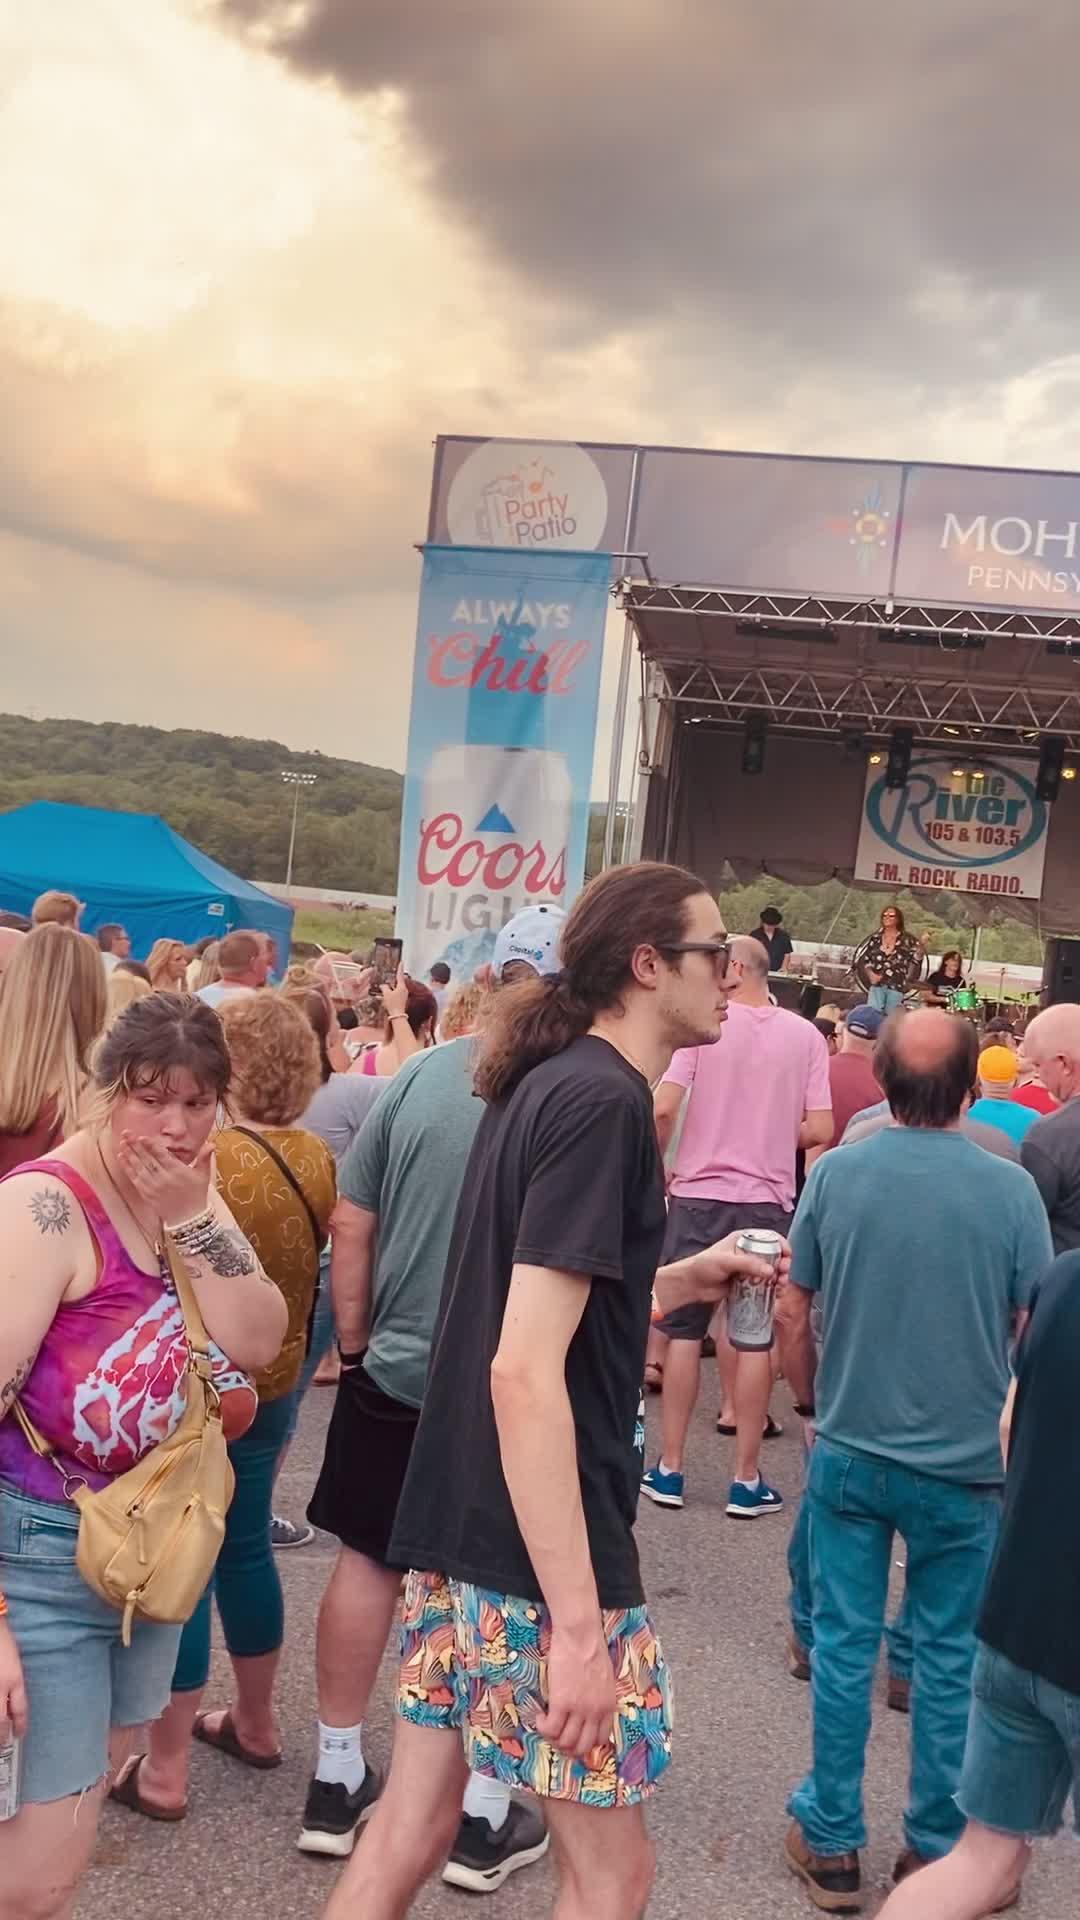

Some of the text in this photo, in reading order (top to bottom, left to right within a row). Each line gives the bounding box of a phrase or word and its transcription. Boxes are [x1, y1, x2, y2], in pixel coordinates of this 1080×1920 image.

[505, 494, 569, 523] Party
[515, 515, 577, 544] Patio
[450, 600, 571, 628] ALWAYS
[426, 631, 592, 694] Chill
[890, 772, 1027, 842] River
[925, 821, 1021, 847] 105 & 103.5
[417, 812, 566, 896] Coors
[875, 862, 1024, 895] FM. ROCK. RADIO.
[425, 891, 556, 931] LIG
[509, 945, 535, 956] Capital
